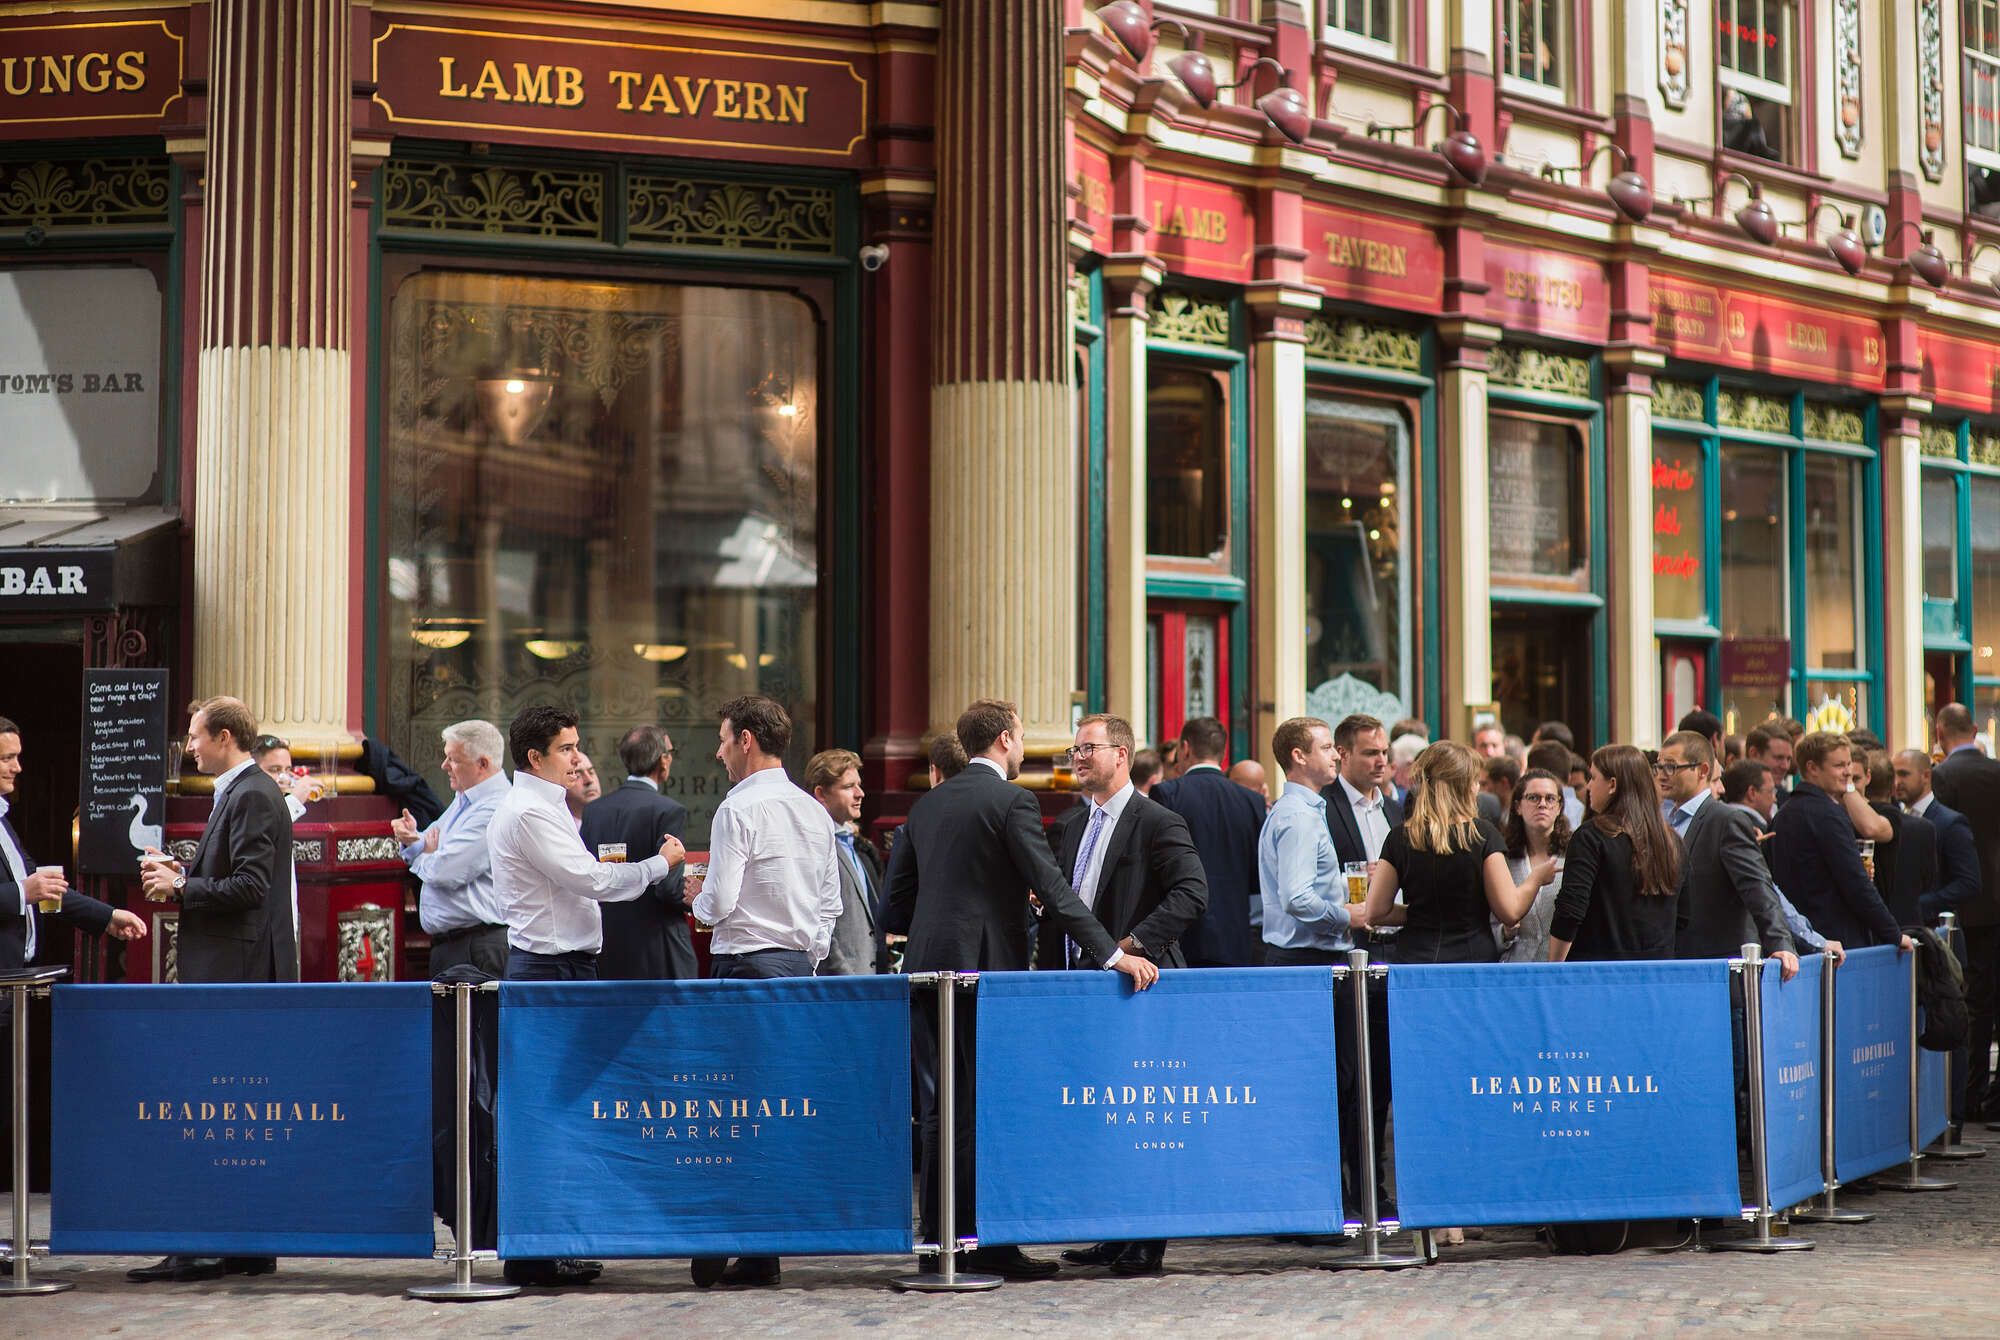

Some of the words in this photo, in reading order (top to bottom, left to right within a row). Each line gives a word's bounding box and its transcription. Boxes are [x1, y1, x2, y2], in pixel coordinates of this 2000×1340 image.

[2, 51, 146, 95] UNGS
[439, 56, 585, 106] LAMB
[608, 70, 809, 123] TAVERN
[1153, 200, 1227, 243] LAMB
[1323, 231, 1408, 277] TAVERN
[1728, 311, 1745, 339] 13
[1785, 320, 1827, 353] LEON
[1863, 336, 1880, 367] 13
[0, 373, 74, 394] TOM'S
[82, 372, 144, 394] BAR
[0, 565, 88, 596] BAR
[90, 683, 111, 694] Come
[114, 682, 129, 691] and
[132, 682, 144, 695] try
[146, 681, 160, 691] our
[107, 694, 127, 706] range
[137, 692, 157, 701] craft
[90, 705, 105, 713] beer
[133, 738, 146, 749] IPA
[662, 775, 720, 795] PIRI
[1471, 1075, 1659, 1095] LEADENHALL
[1061, 1085, 1257, 1105] LEADENHALL
[137, 1102, 345, 1121] LEADENHALL
[591, 1097, 818, 1120] LEADENHALL
[1512, 1099, 1614, 1113] MARKET
[1106, 1110, 1209, 1125] MARKET
[183, 1127, 293, 1141] MARKET
[641, 1124, 761, 1140] MARKET
[1541, 1129, 1591, 1137] LONDON
[1135, 1141, 1185, 1150] LONDON
[213, 1158, 267, 1166] LONDON
[676, 1156, 733, 1165] LONDON
